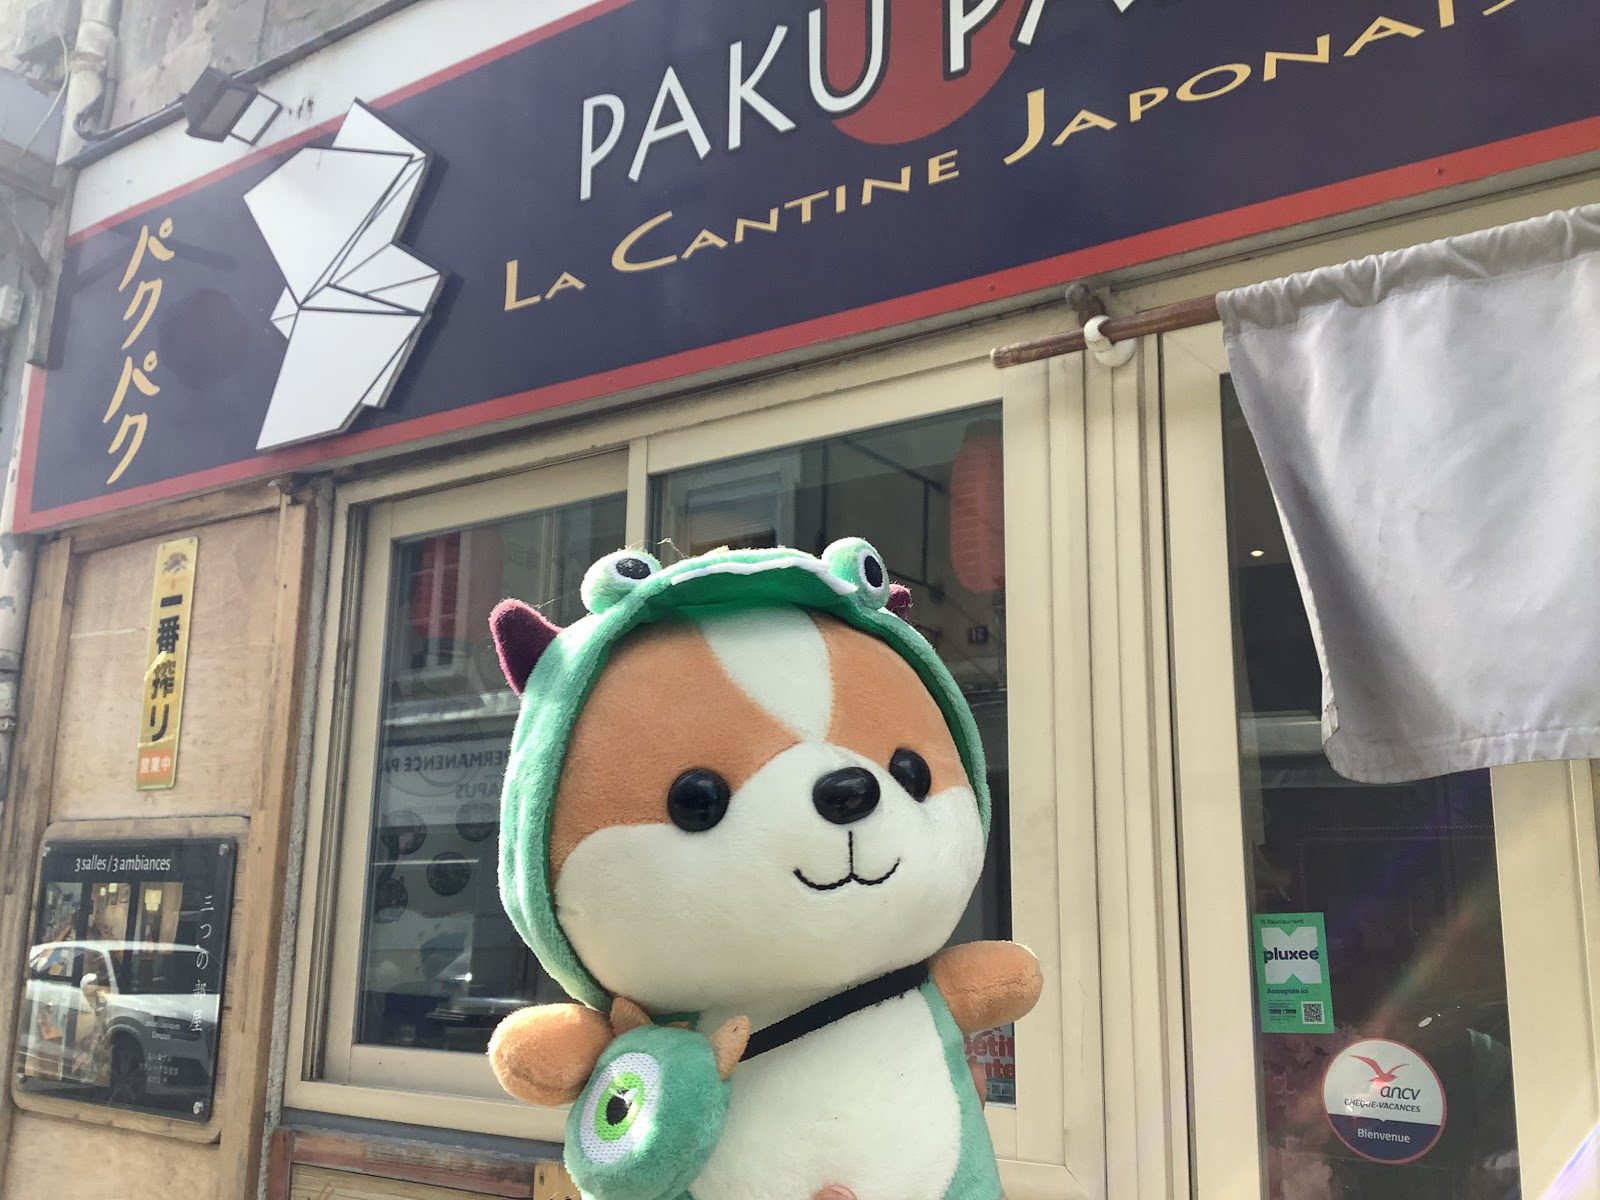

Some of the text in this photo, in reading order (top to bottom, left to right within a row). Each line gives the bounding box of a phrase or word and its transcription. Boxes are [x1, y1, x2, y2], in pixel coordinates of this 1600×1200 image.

[579, 0, 885, 201] PAKU
[611, 149, 959, 273] CANTINE
[1003, 0, 1517, 166] JAPONAI
[103, 217, 175, 484] パクパク
[81, 855, 106, 871] salles
[120, 855, 171, 871] ambiances
[1263, 947, 1319, 964] pluxee
[1380, 1085, 1421, 1101] ancv
[1358, 1128, 1411, 1144] Bienvenue
